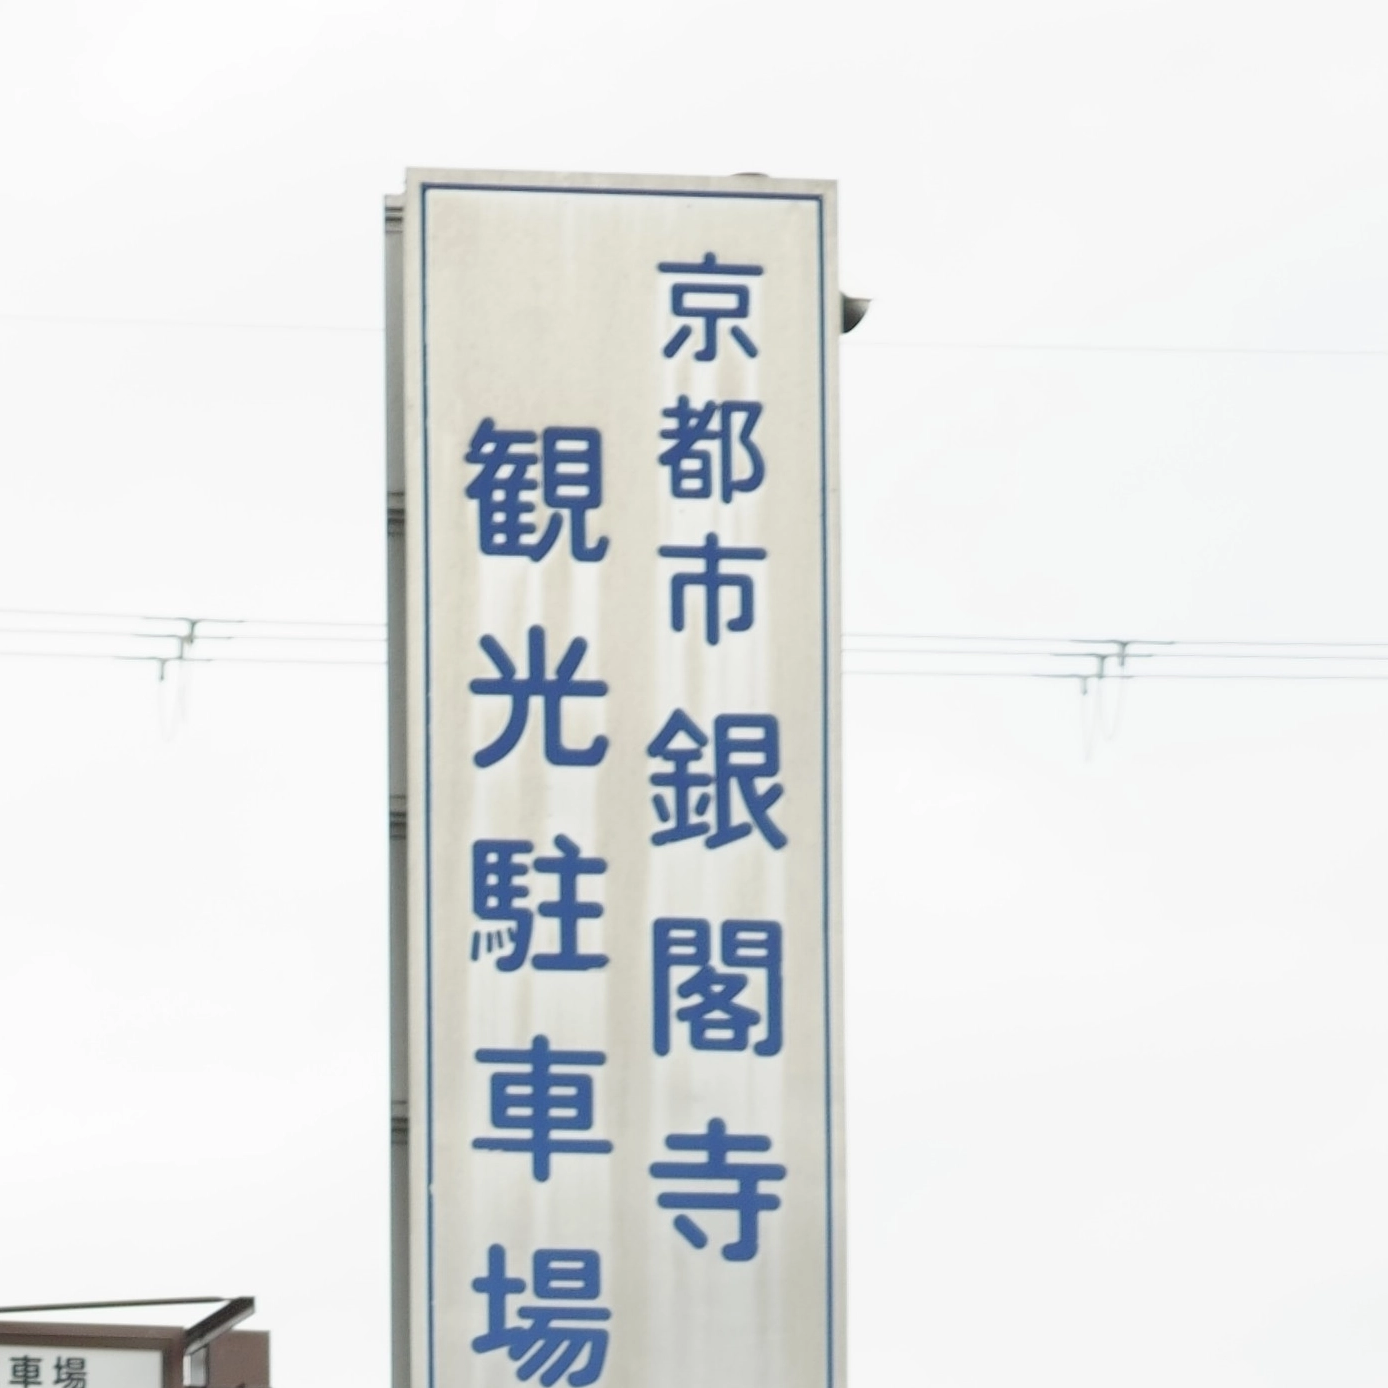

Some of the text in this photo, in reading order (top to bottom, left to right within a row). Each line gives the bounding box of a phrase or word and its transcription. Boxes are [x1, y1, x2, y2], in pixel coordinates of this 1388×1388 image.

[465, 416, 613, 1388] 観光駐車場
[647, 252, 789, 1262] 京都市銀閣寺
